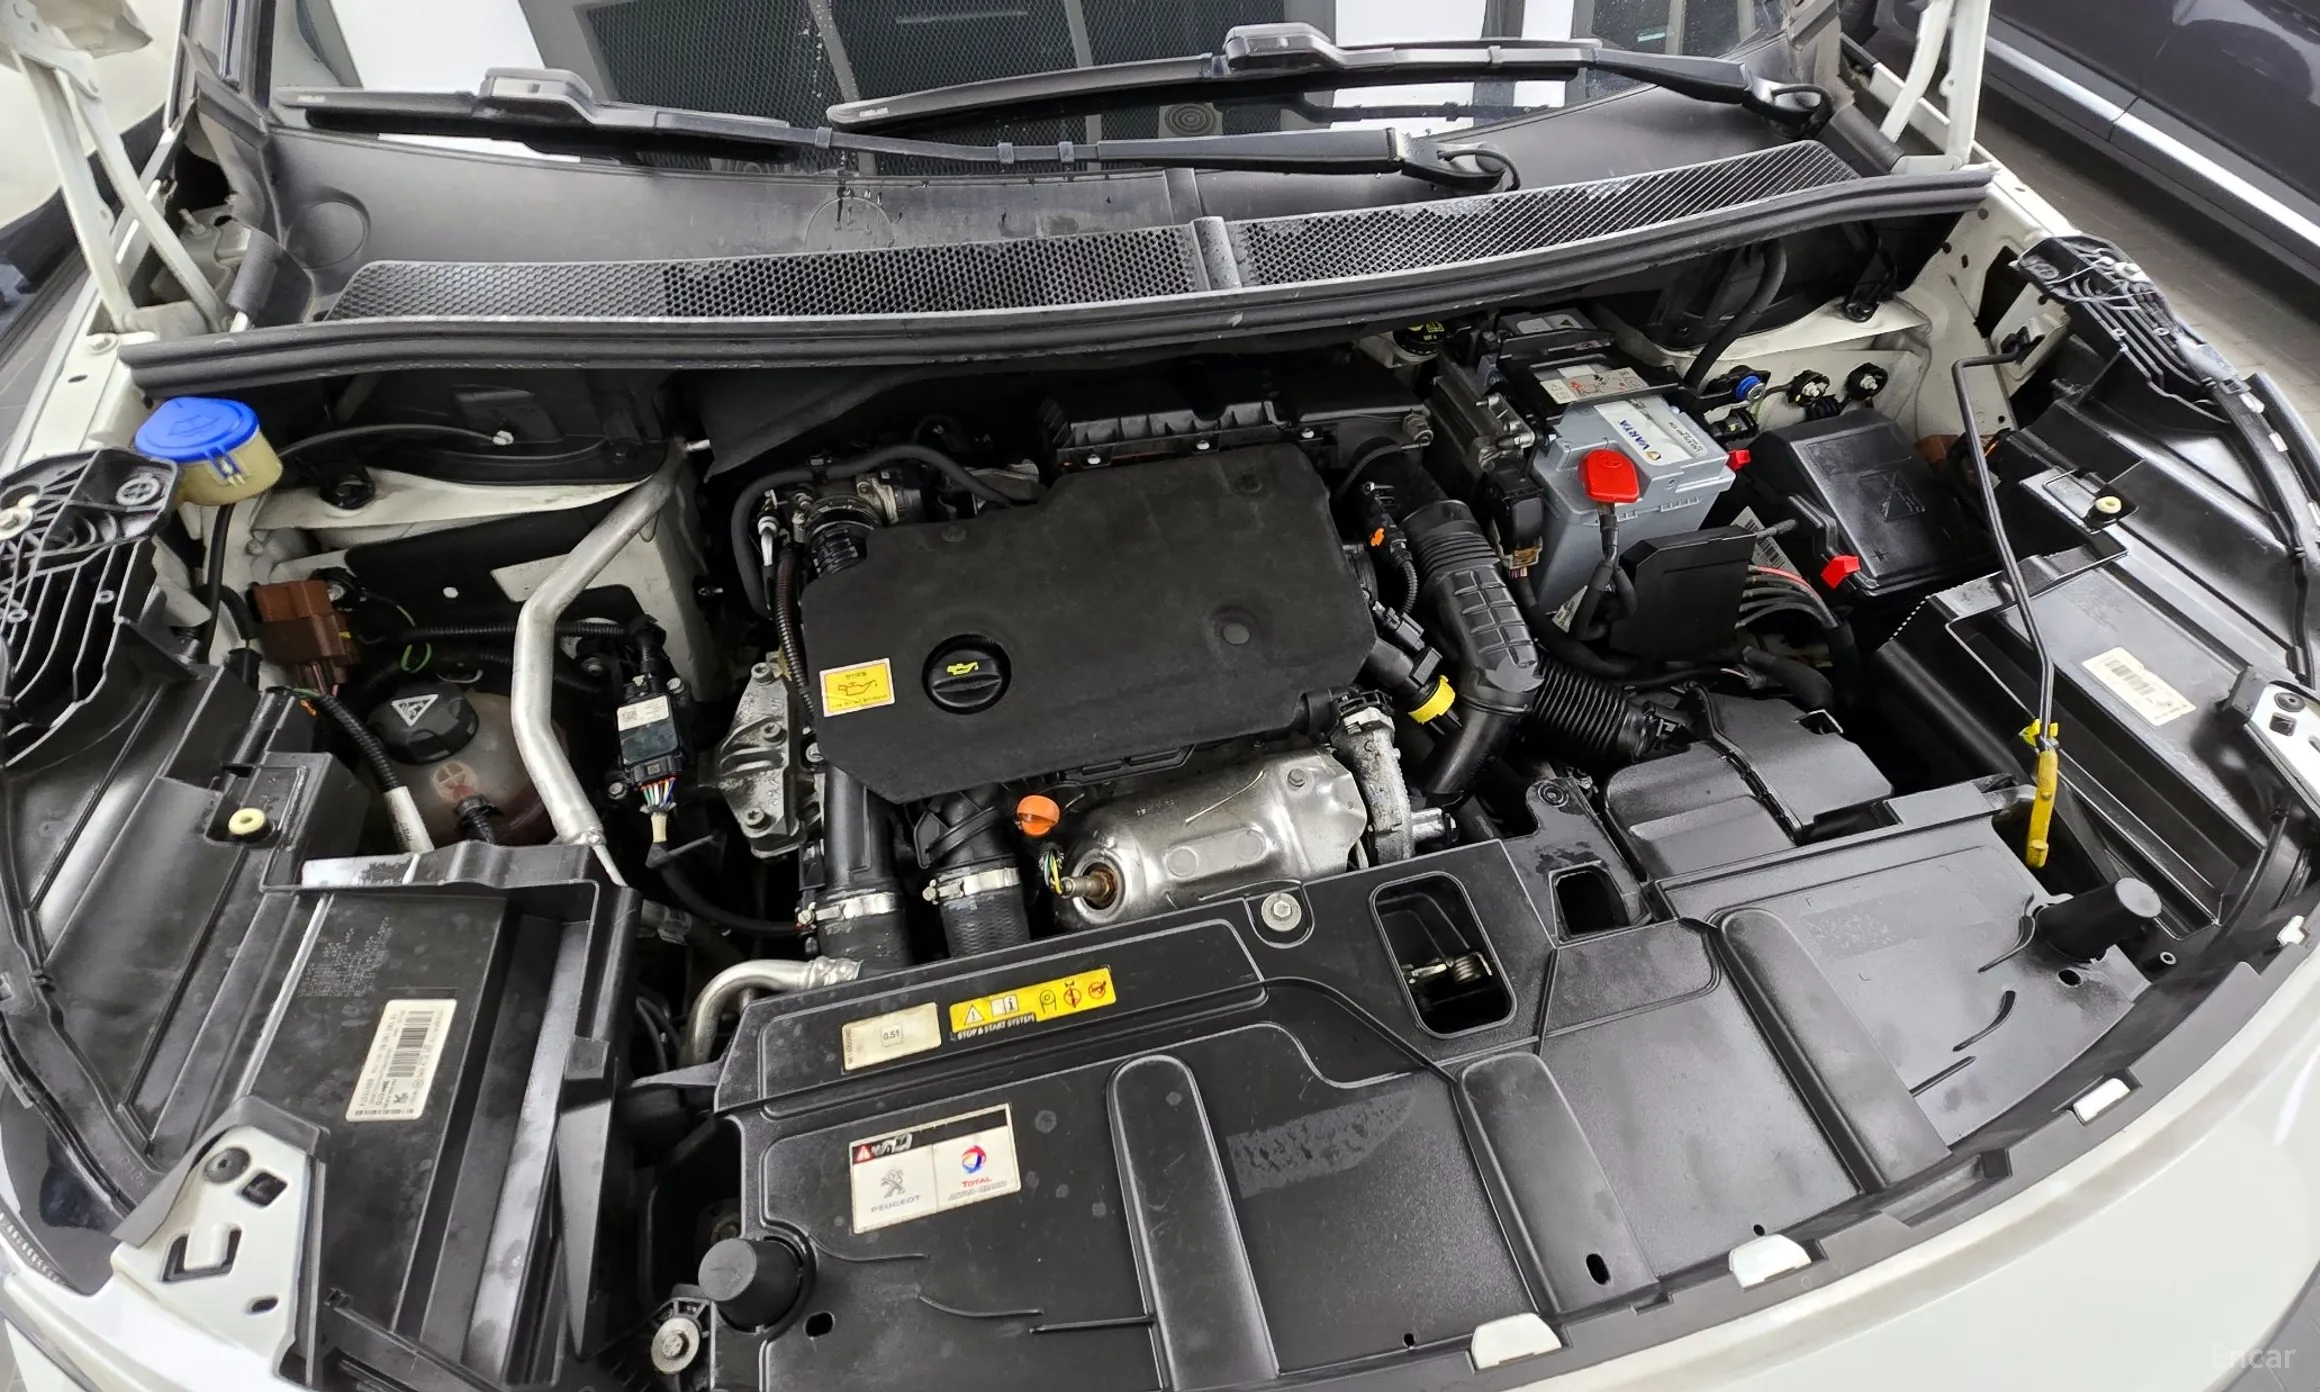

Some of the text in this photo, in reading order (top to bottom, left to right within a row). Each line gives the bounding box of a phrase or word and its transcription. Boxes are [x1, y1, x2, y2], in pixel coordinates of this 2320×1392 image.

[1619, 419, 1650, 450] VARTA
[1007, 1013, 1035, 1028] SYSTEM
[883, 1029, 900, 1041] 0.51
[961, 1177, 992, 1189] TOTAL
[870, 1194, 921, 1213] PEUGEOT
